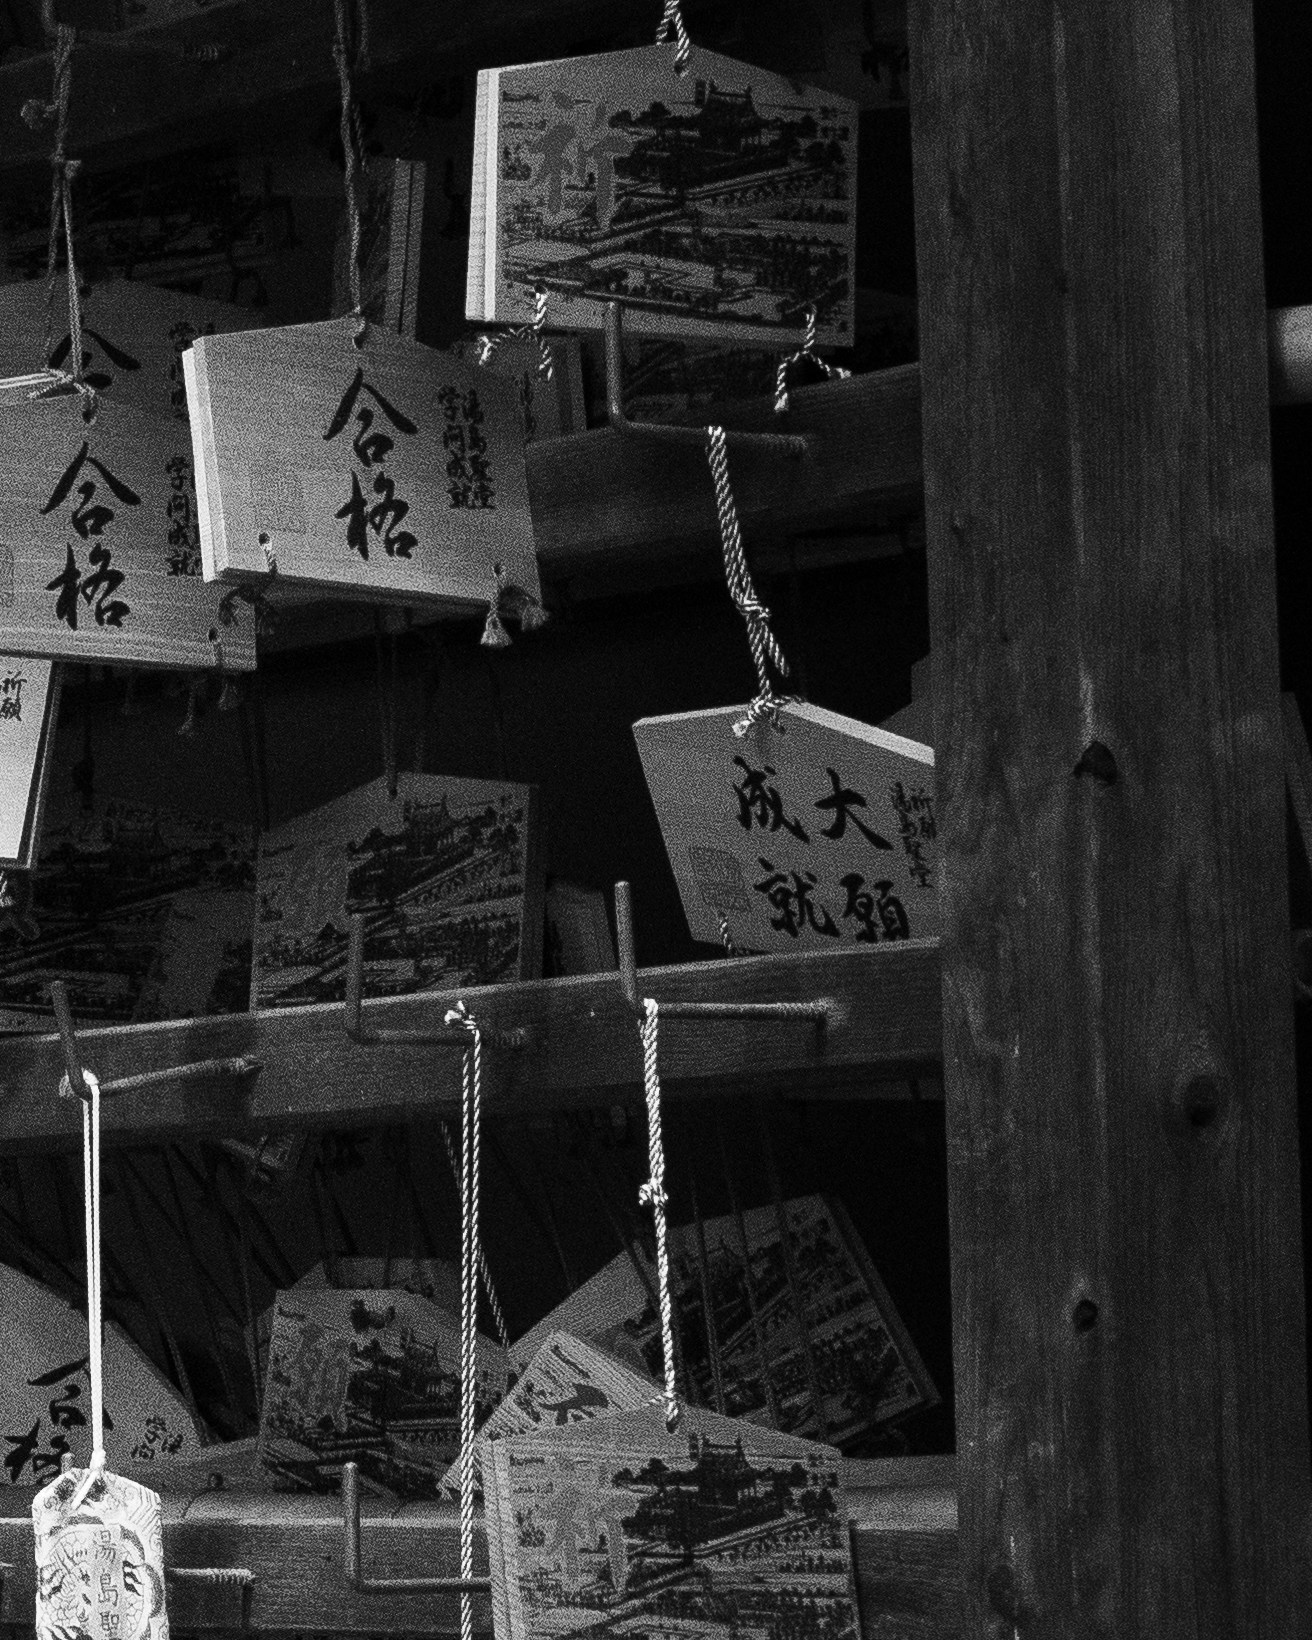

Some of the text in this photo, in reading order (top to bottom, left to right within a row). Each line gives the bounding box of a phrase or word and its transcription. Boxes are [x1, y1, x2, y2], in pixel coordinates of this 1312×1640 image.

[41, 441, 142, 632] 合格
[322, 367, 419, 560] 合格
[732, 757, 840, 938] 成就
[814, 767, 910, 944] 大願
